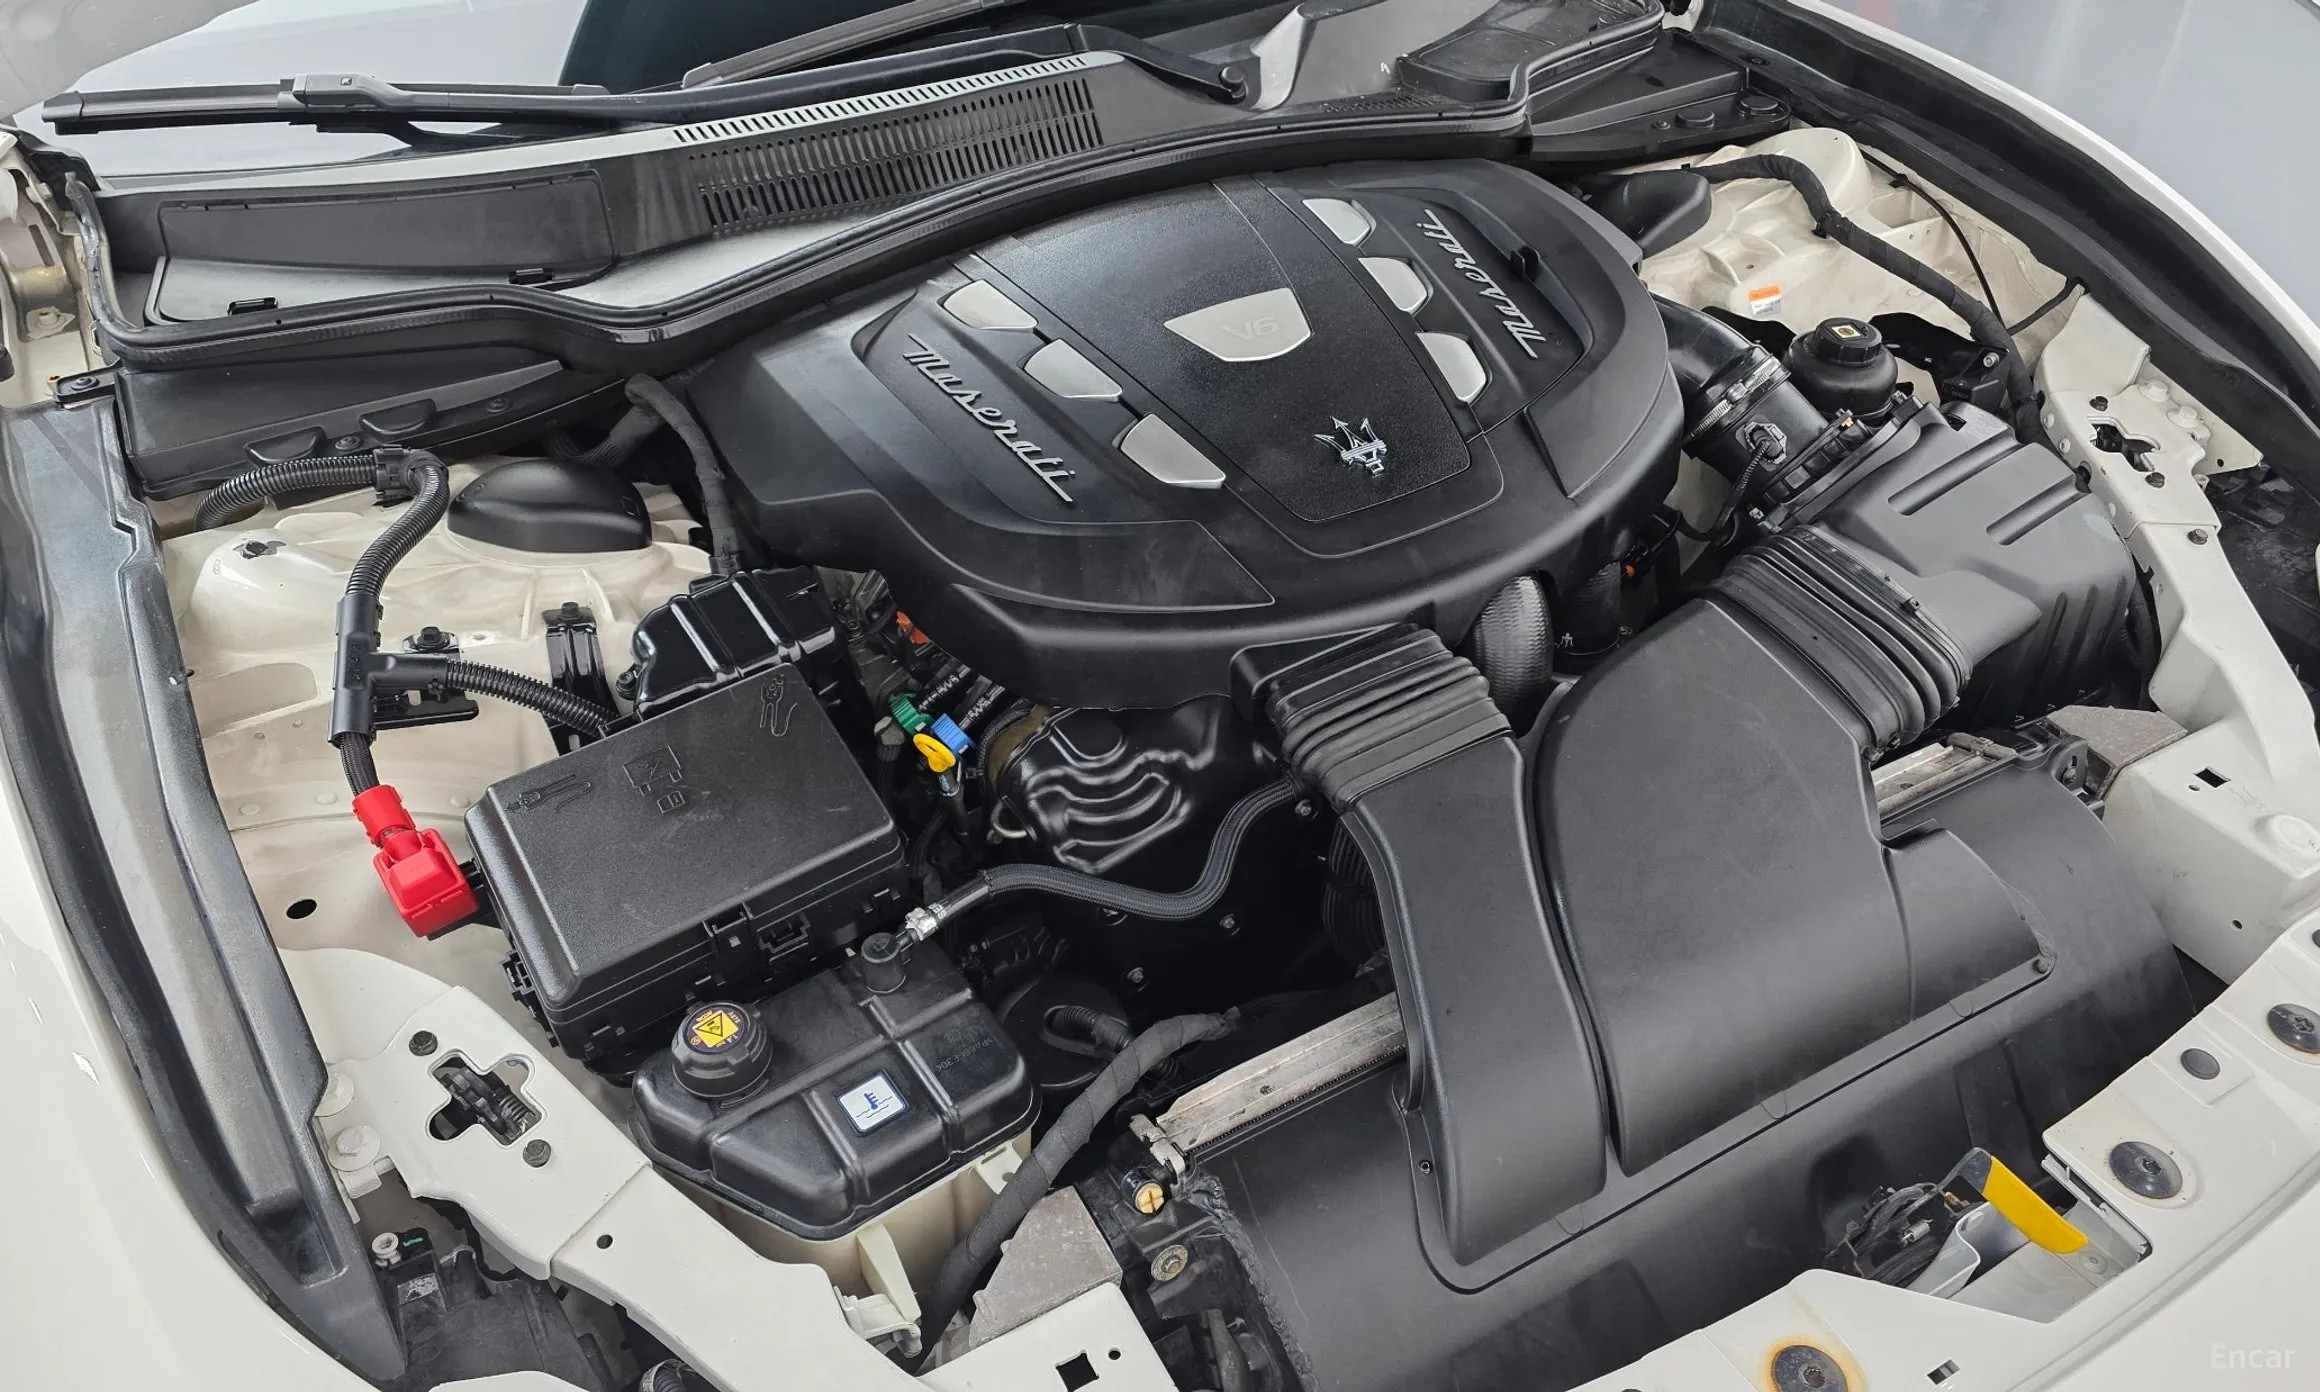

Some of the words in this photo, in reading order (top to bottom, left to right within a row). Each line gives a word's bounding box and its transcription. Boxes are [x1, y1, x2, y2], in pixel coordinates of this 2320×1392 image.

[1220, 315, 1280, 340] V6
[1416, 209, 1547, 359] Maserati
[902, 332, 1076, 502] Maserati
